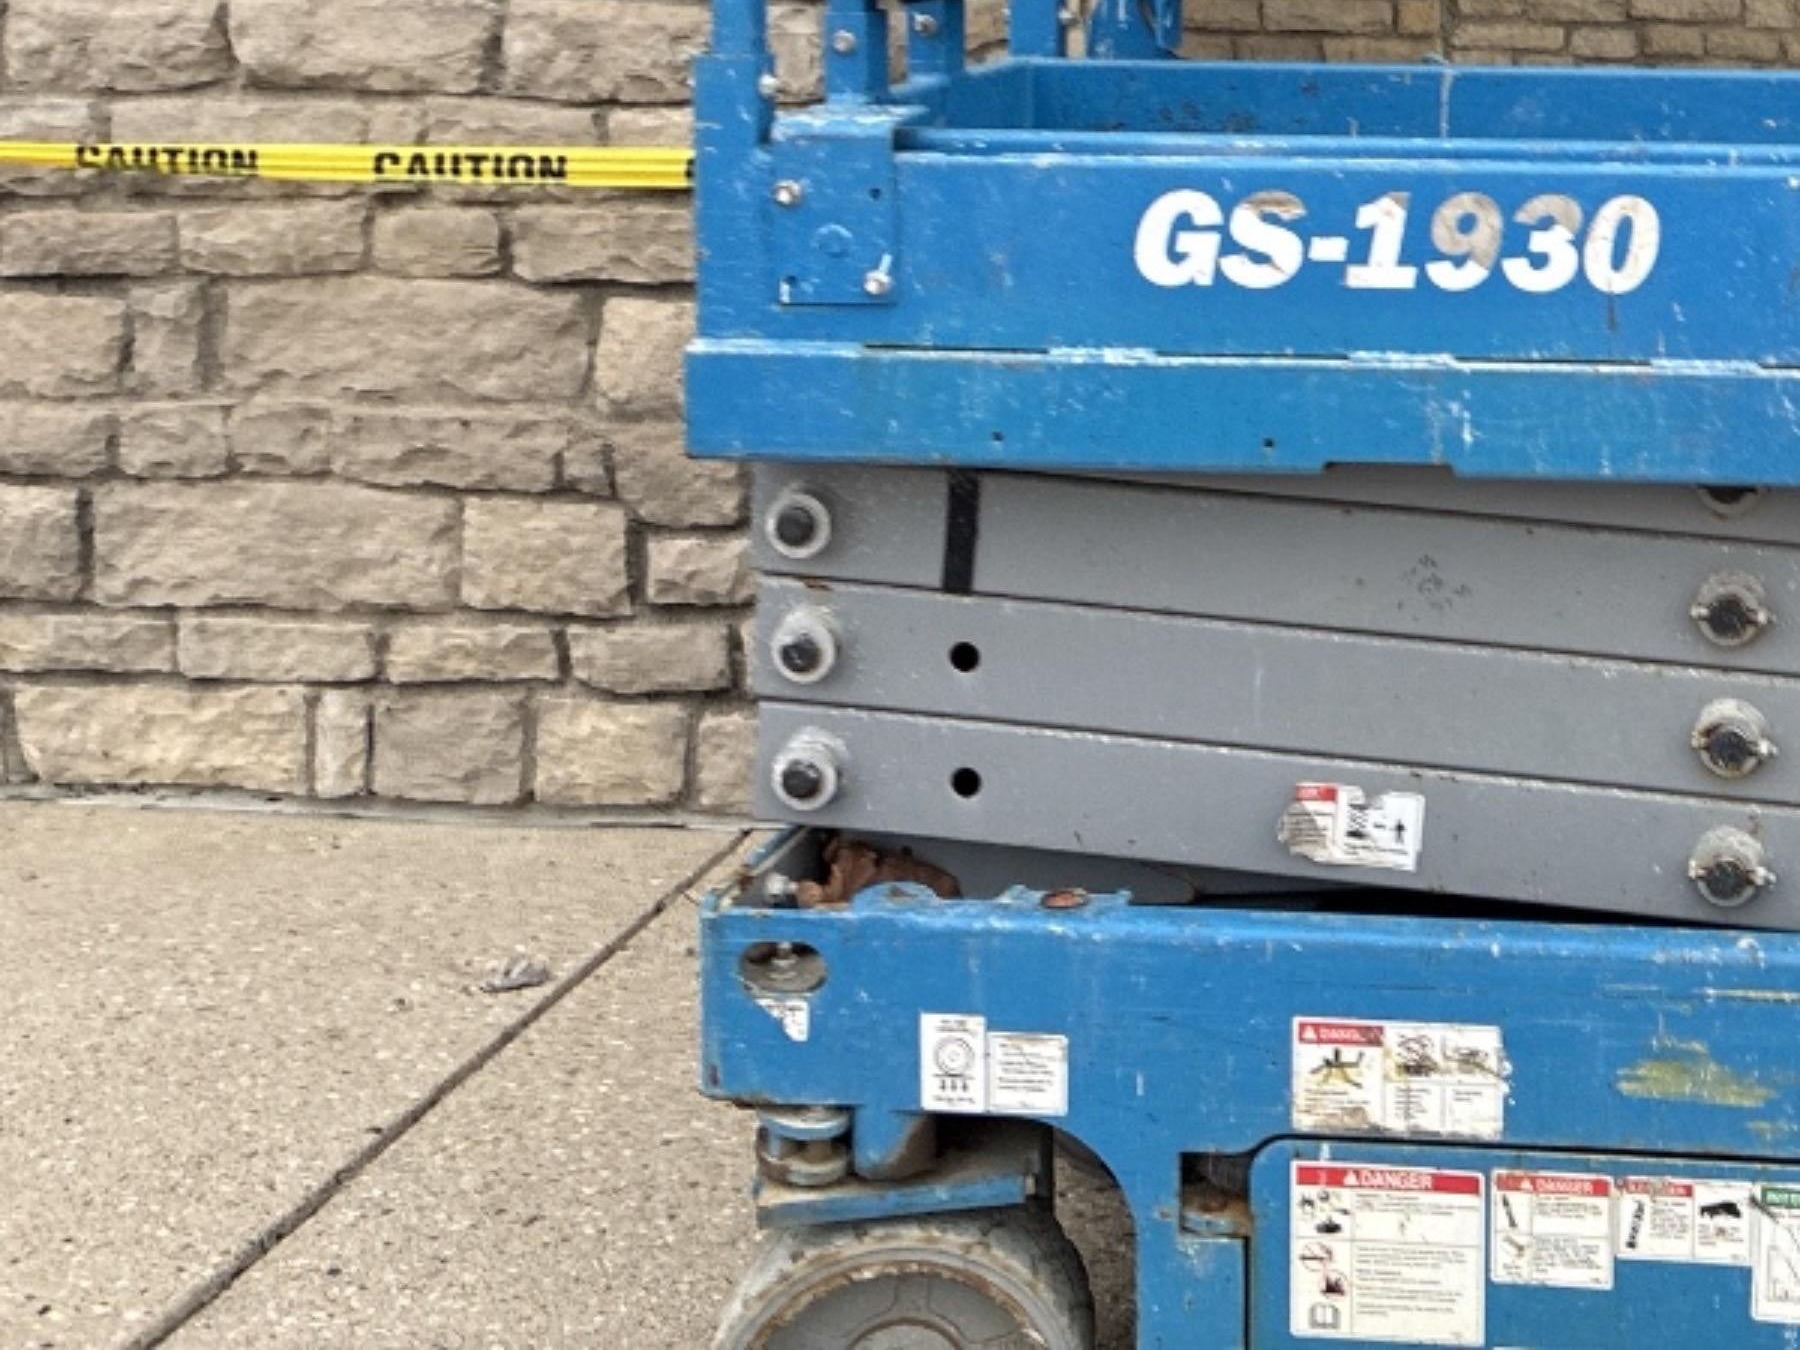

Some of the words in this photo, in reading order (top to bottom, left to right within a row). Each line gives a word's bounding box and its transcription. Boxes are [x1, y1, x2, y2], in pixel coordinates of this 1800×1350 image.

[374, 153, 567, 179] CAUTION
[1133, 188, 1661, 295] GS-1930
[1360, 1170, 1433, 1189] DANGER
[1535, 1177, 1594, 1195] DANGER
